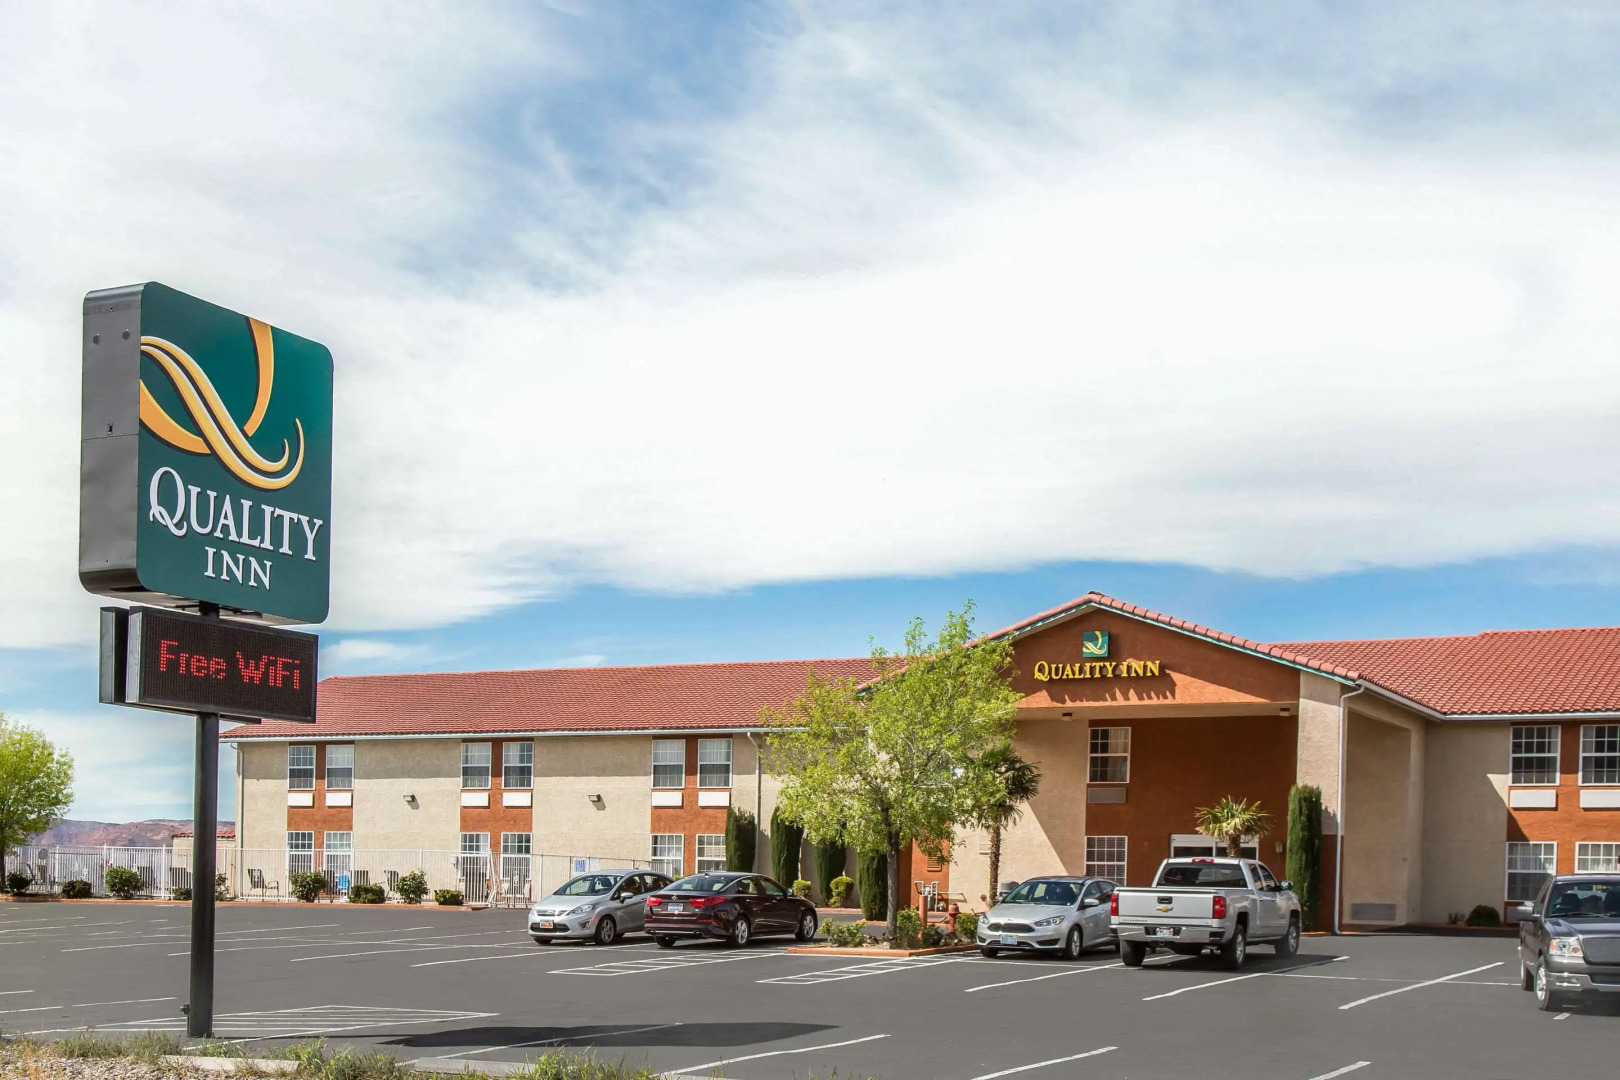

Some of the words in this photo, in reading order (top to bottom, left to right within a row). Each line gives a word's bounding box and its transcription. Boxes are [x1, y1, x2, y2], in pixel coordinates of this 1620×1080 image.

[149, 466, 323, 561] QUALITY
[204, 546, 272, 590] INN
[159, 639, 227, 680] Free
[236, 651, 300, 690] WiFi
[1034, 660, 1117, 682] QUALITY
[1121, 660, 1161, 677] INN
